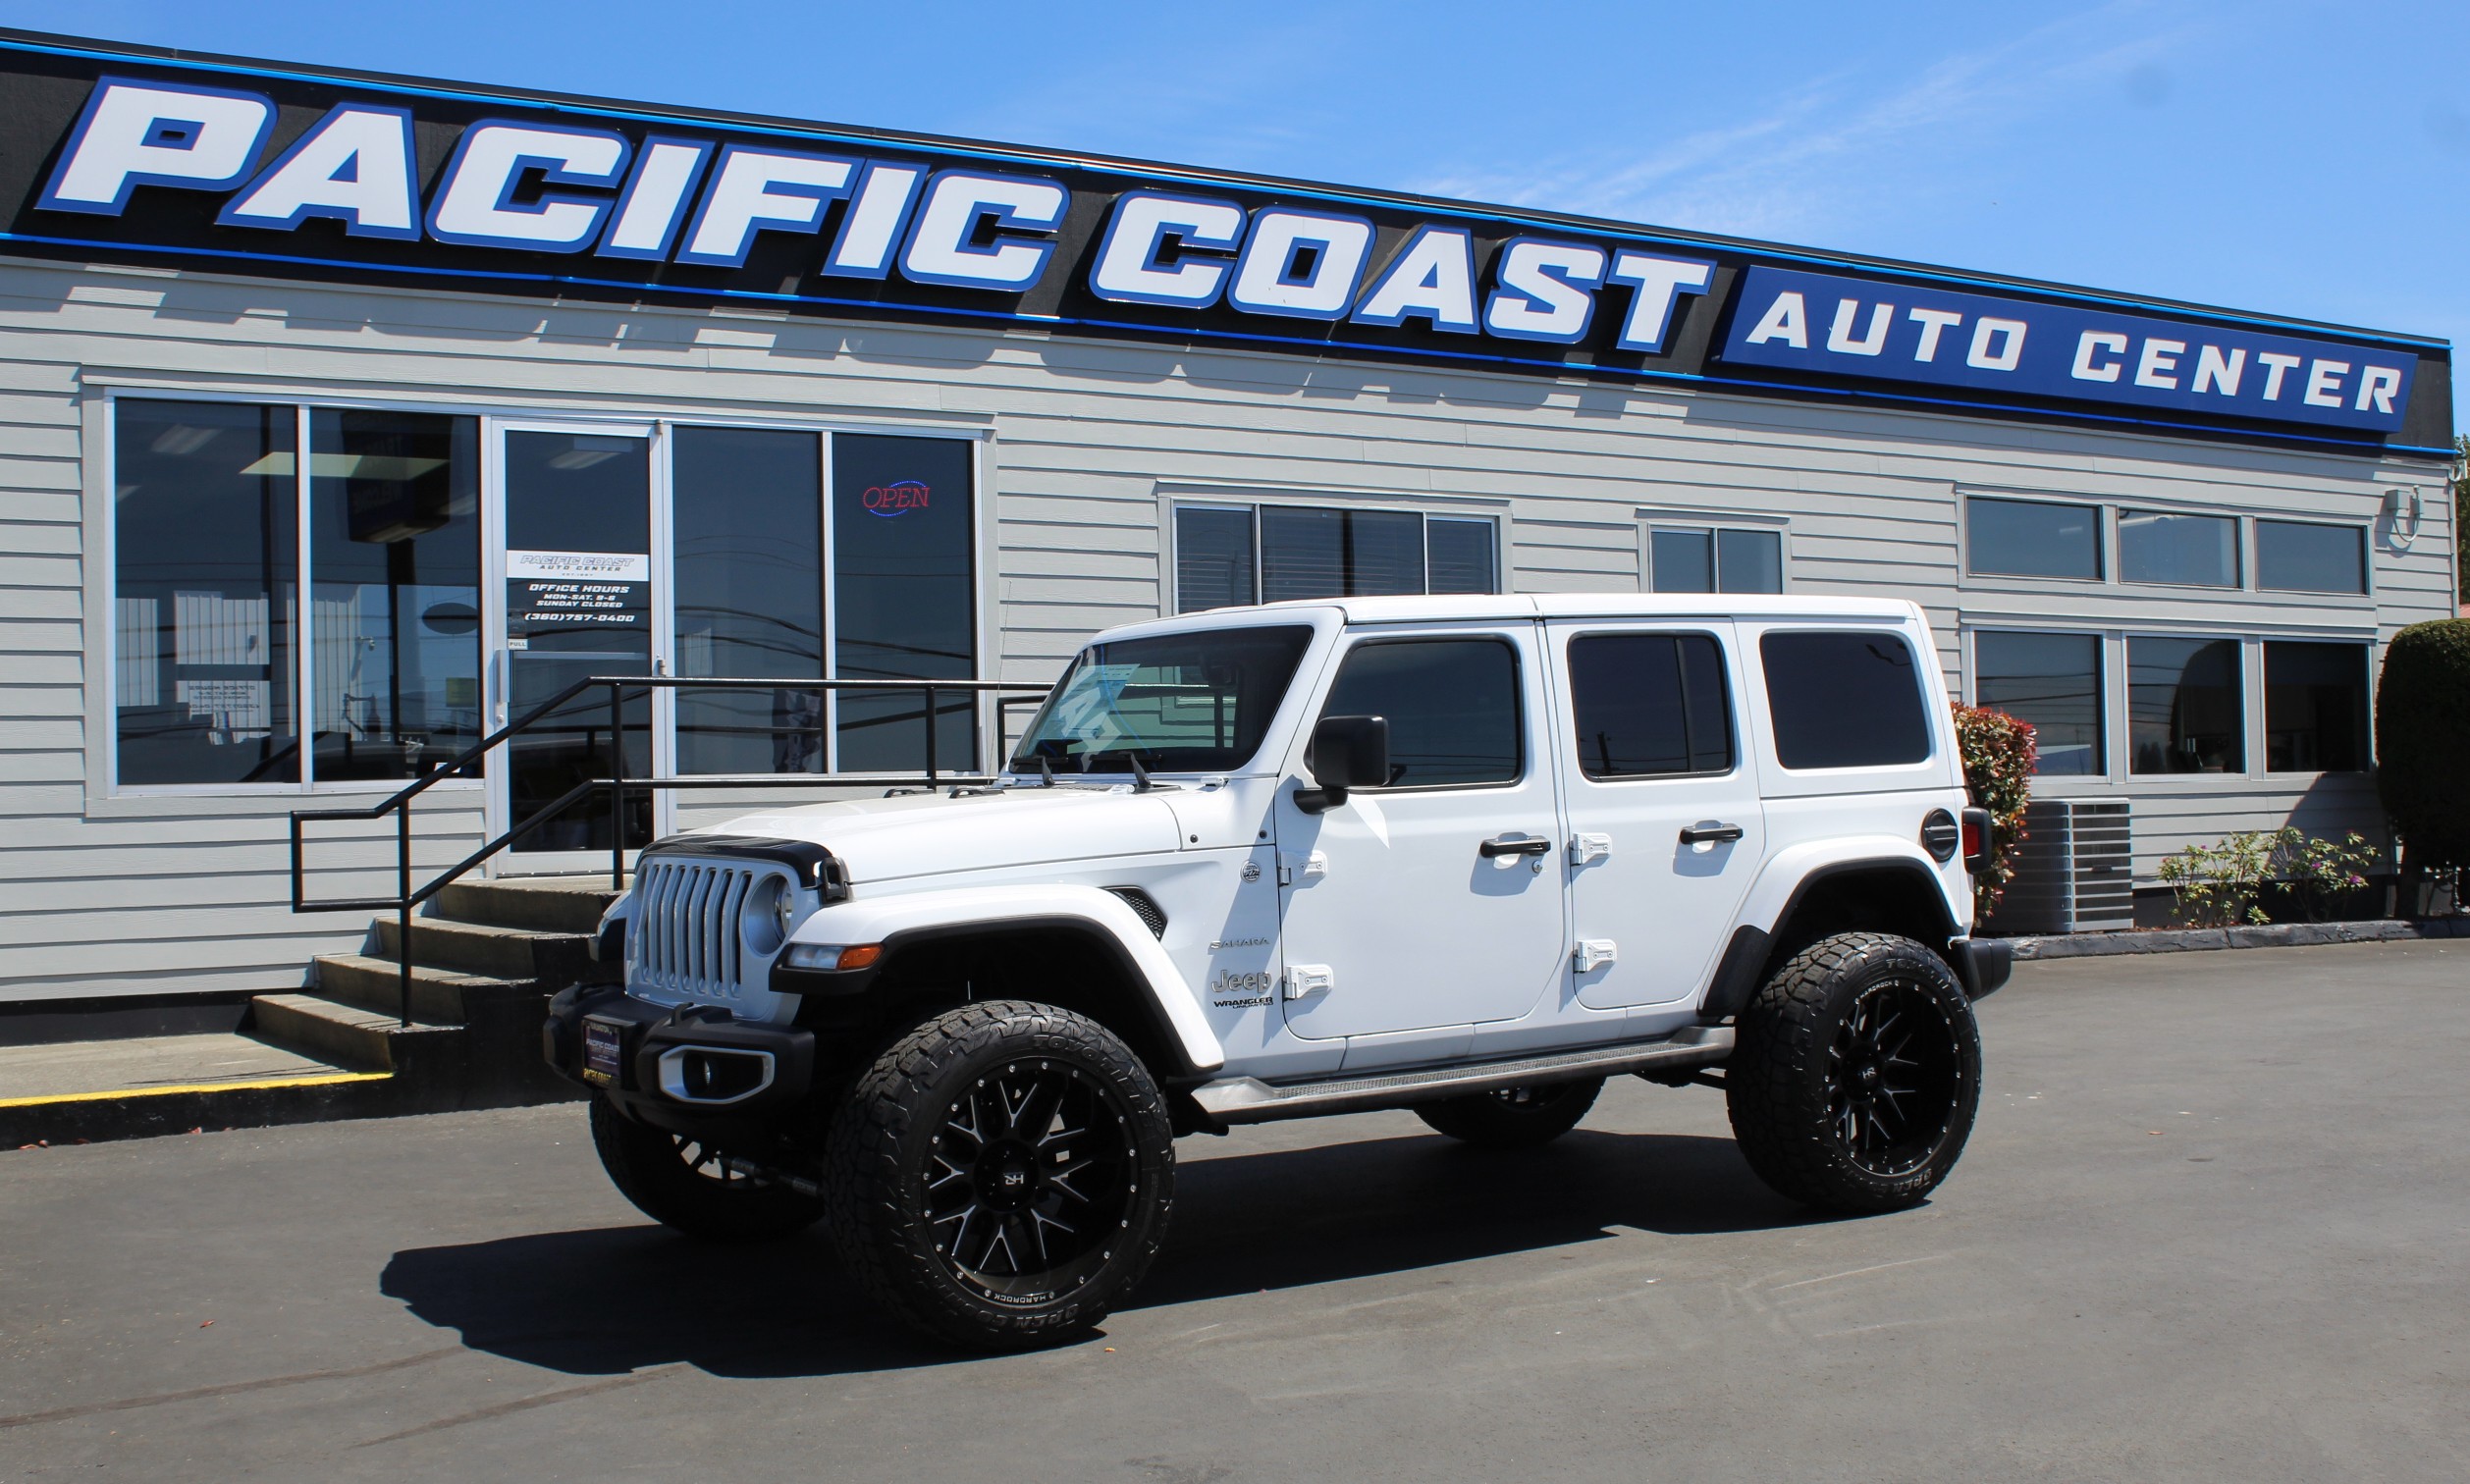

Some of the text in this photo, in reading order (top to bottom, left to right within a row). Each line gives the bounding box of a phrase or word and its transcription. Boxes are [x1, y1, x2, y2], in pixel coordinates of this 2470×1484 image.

[34, 75, 1719, 353] PACIFIC COAST
[1745, 291, 2401, 414] AUTO CENTER
[863, 487, 931, 508] OPEN
[520, 556, 634, 567] PACIFIC COAST
[528, 583, 629, 594] OFFICE HOURS
[524, 612, 635, 622] (360)757-0400
[1210, 937, 1270, 949] SAHARA
[1211, 970, 1272, 993] Jeep
[1860, 981, 1893, 999] HARDROCK
[1213, 997, 1273, 1007] WRANGLER
[605, 1042, 619, 1052] COAST
[1034, 1034, 1101, 1060] TOYO
[993, 1293, 1047, 1304] HARDROCK
